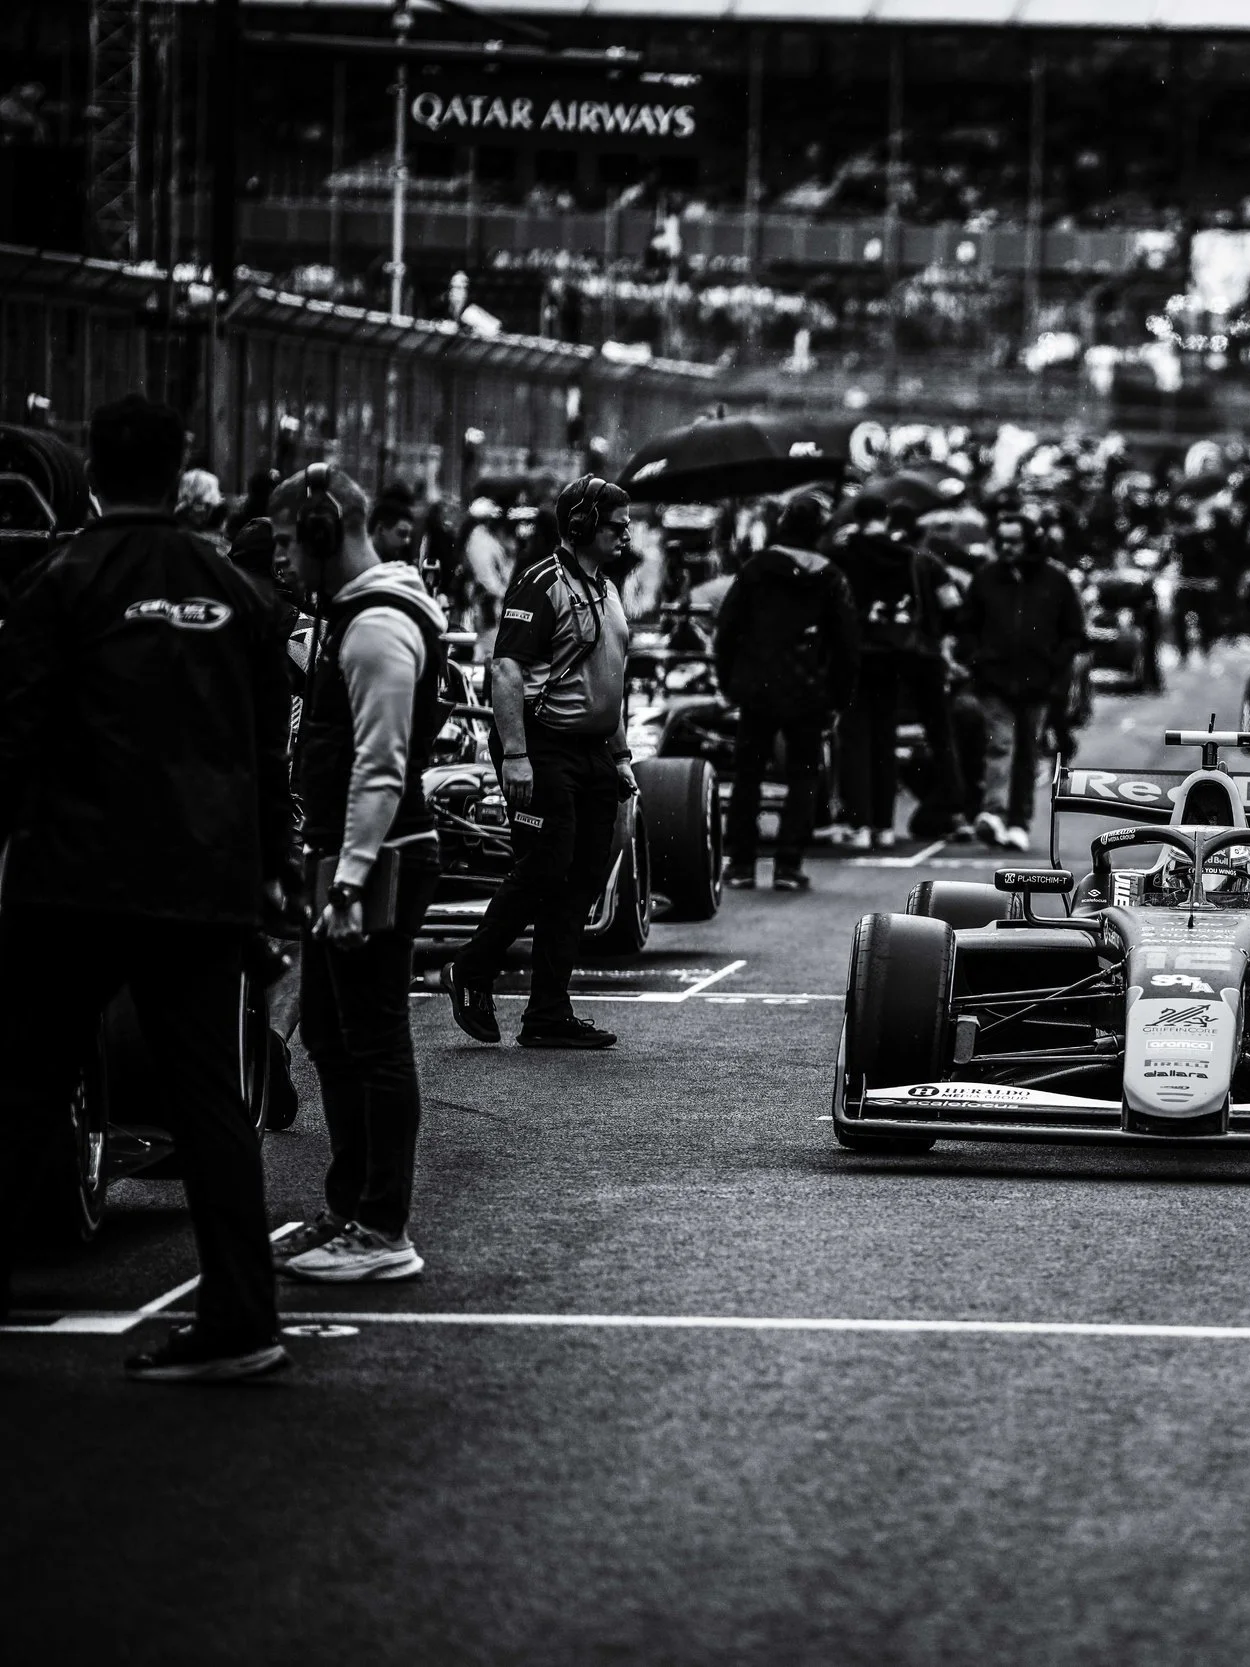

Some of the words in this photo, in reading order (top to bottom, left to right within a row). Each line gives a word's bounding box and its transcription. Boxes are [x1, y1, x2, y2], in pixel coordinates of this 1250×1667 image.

[410, 92, 533, 131] QATAR
[541, 100, 696, 139] AIRWAYS
[1017, 874, 1068, 885] PLASTCHIM-T
[1138, 945, 1233, 971] 12
[1149, 1041, 1208, 1049] aramco
[1145, 1059, 1210, 1068] PIRELLI
[1144, 1070, 1209, 1079] dallara
[944, 1088, 1031, 1096] HERALDO
[906, 1100, 1019, 1109] scalefocus
